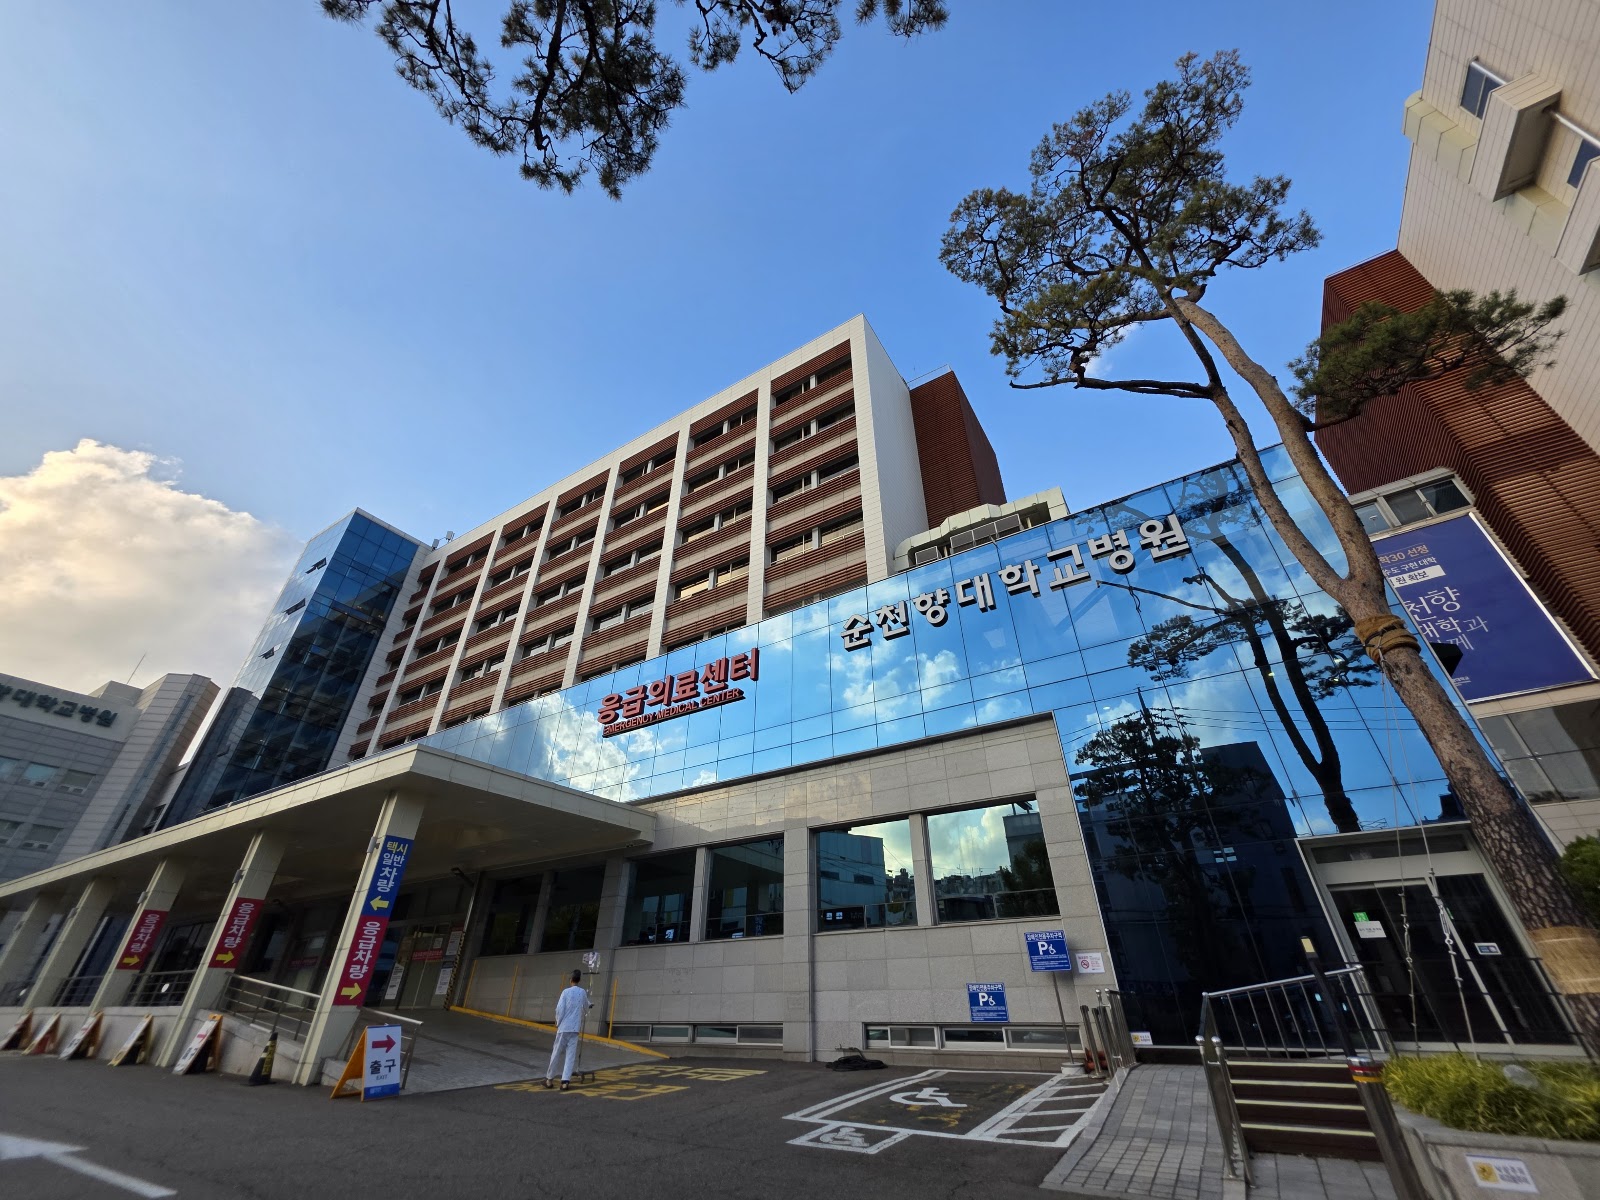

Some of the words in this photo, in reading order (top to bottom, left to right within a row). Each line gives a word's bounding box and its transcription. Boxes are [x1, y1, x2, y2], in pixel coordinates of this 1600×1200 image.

[1407, 544, 1429, 558] 선정
[1401, 562, 1418, 572] 구현
[1418, 556, 1437, 566] 대학
[840, 513, 1191, 652] 순천향대학교병원
[1407, 570, 1429, 582] 확보
[597, 647, 759, 725] 응급의료센터
[602, 713, 655, 736] EMERGENCY
[656, 700, 699, 720] MEDICAL
[700, 687, 742, 708] CENTER
[386, 841, 408, 855] 택시
[383, 853, 405, 867] 일반
[377, 867, 397, 893] 차량
[131, 913, 160, 953] 응급차량
[224, 902, 255, 949] 응급차량
[349, 921, 381, 980] 응급차량
[1037, 941, 1048, 955] P
[978, 992, 988, 1006] P
[370, 1058, 396, 1075] 출구
